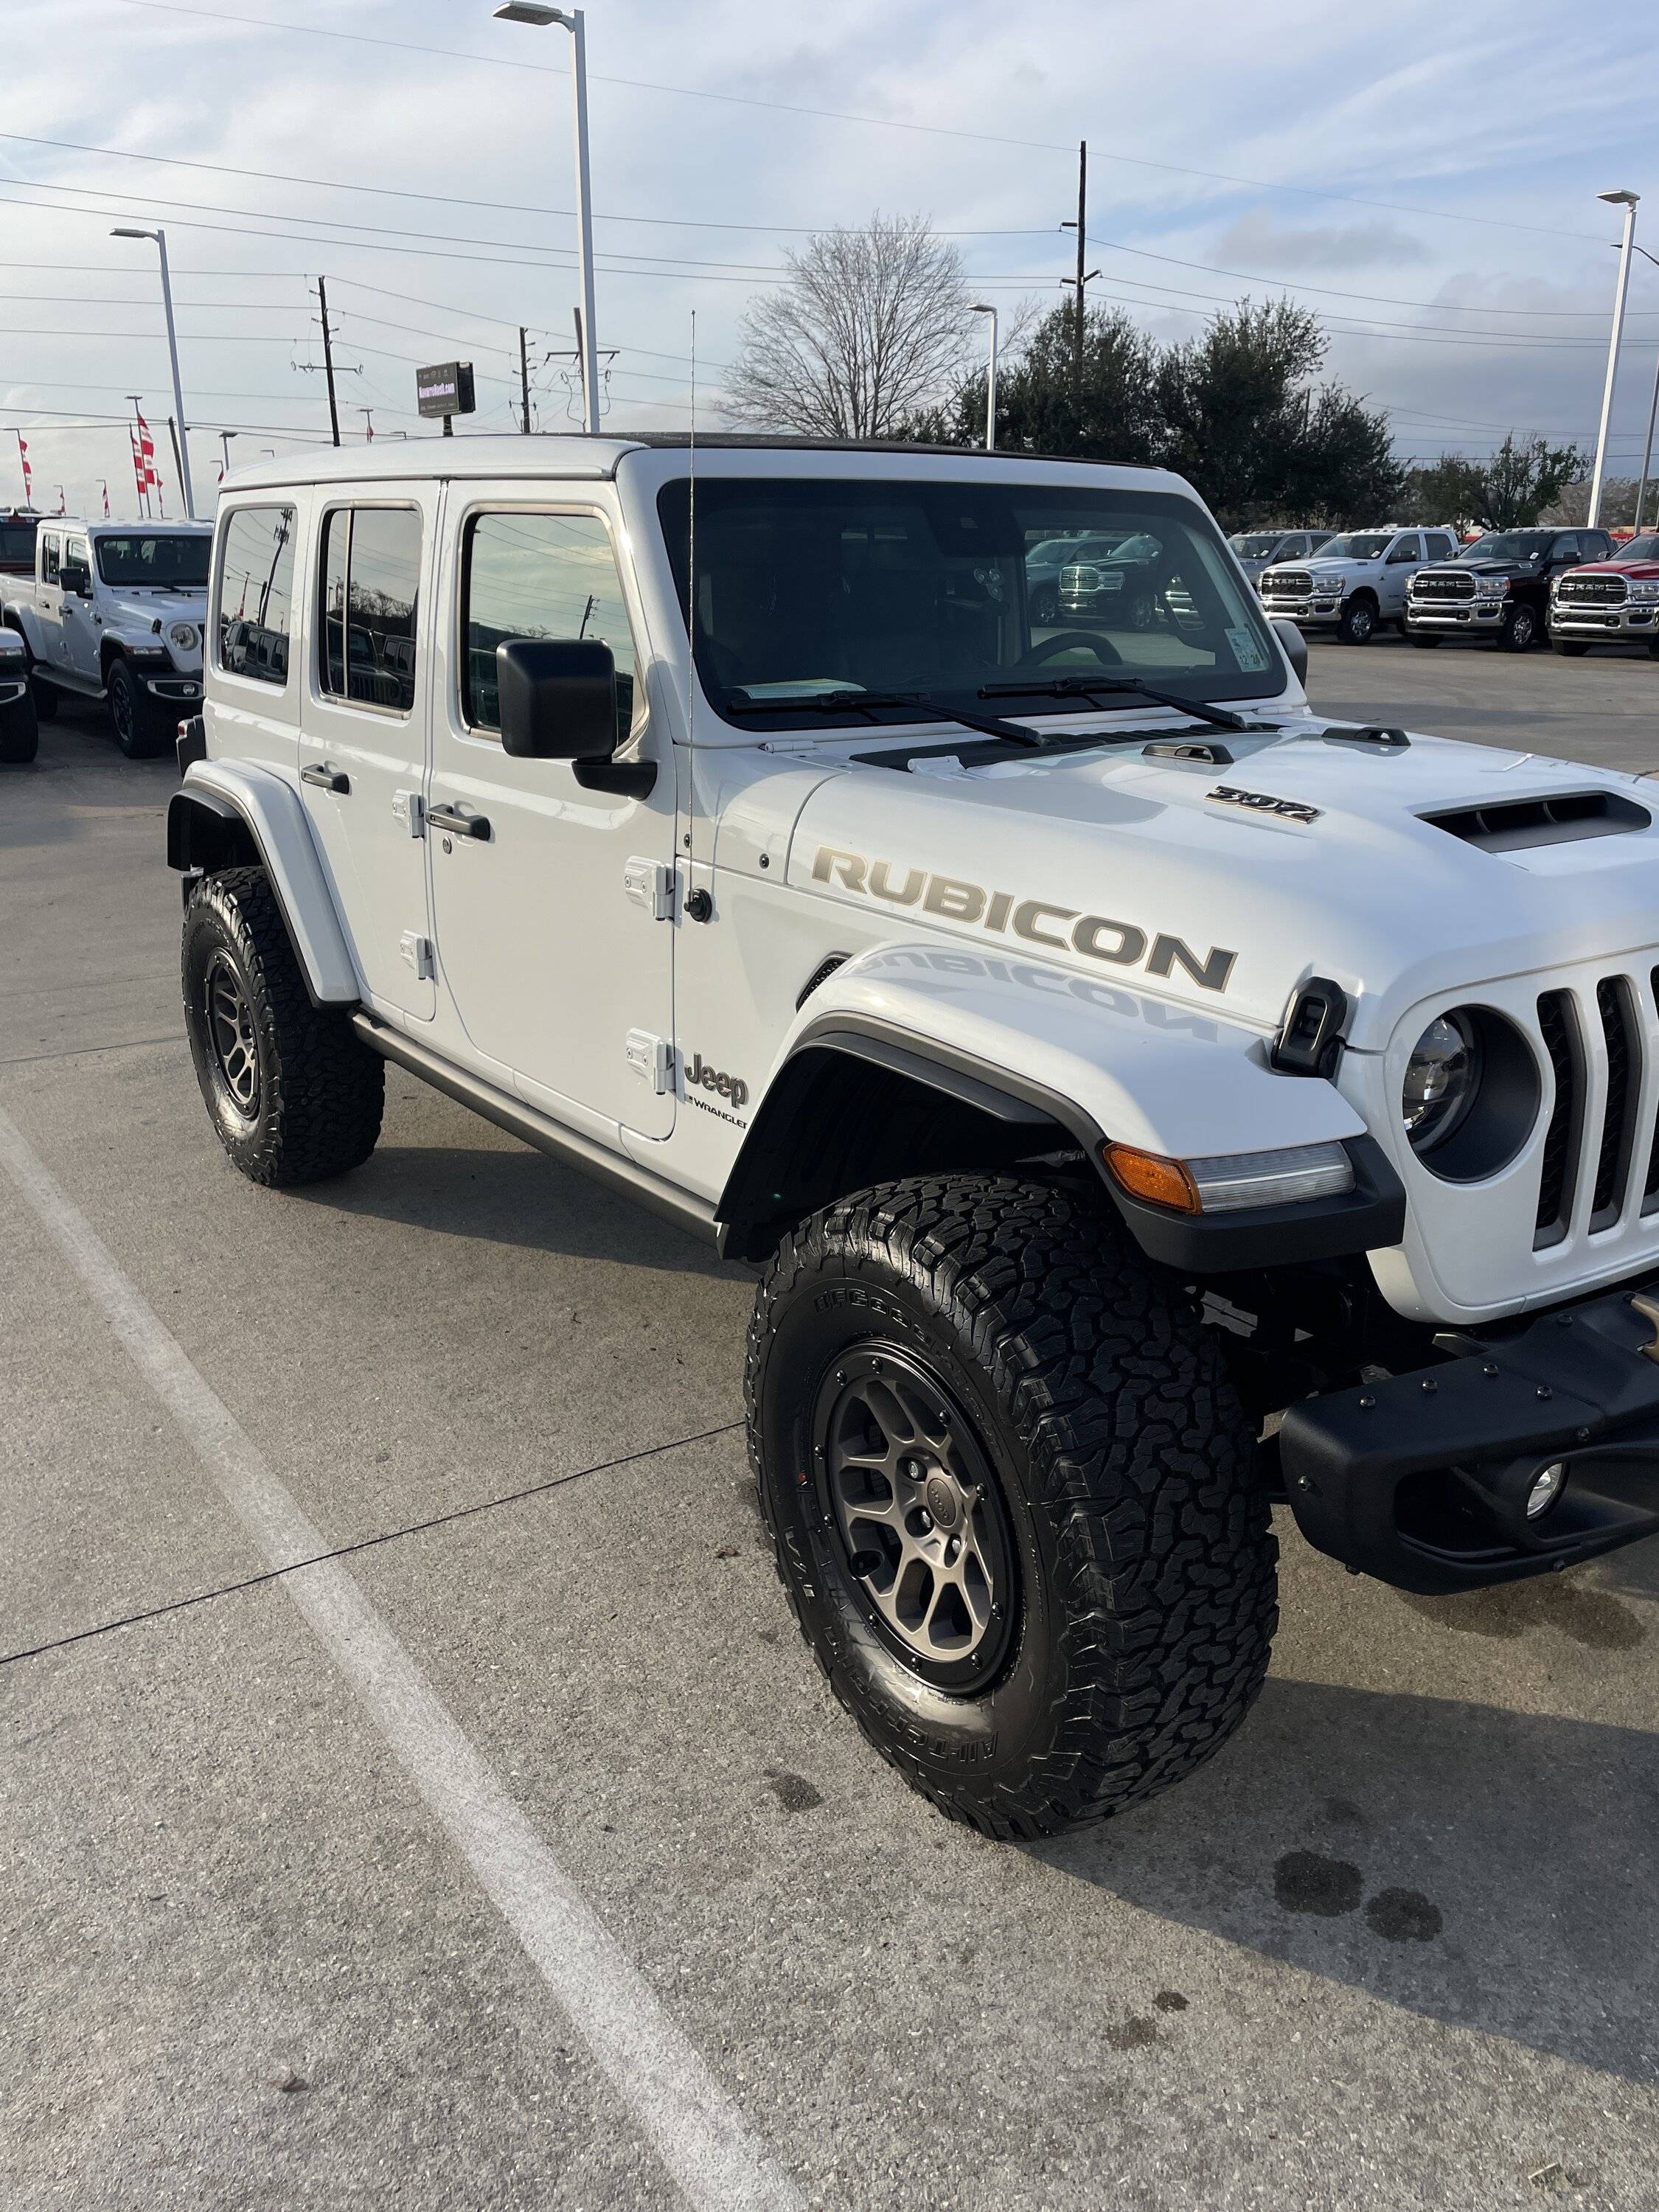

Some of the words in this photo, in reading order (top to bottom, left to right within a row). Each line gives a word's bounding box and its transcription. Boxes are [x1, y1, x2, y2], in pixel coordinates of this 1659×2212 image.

[1203, 785, 1320, 824] 392
[811, 844, 1239, 994] RUBICON
[684, 1052, 748, 1109] Jeep
